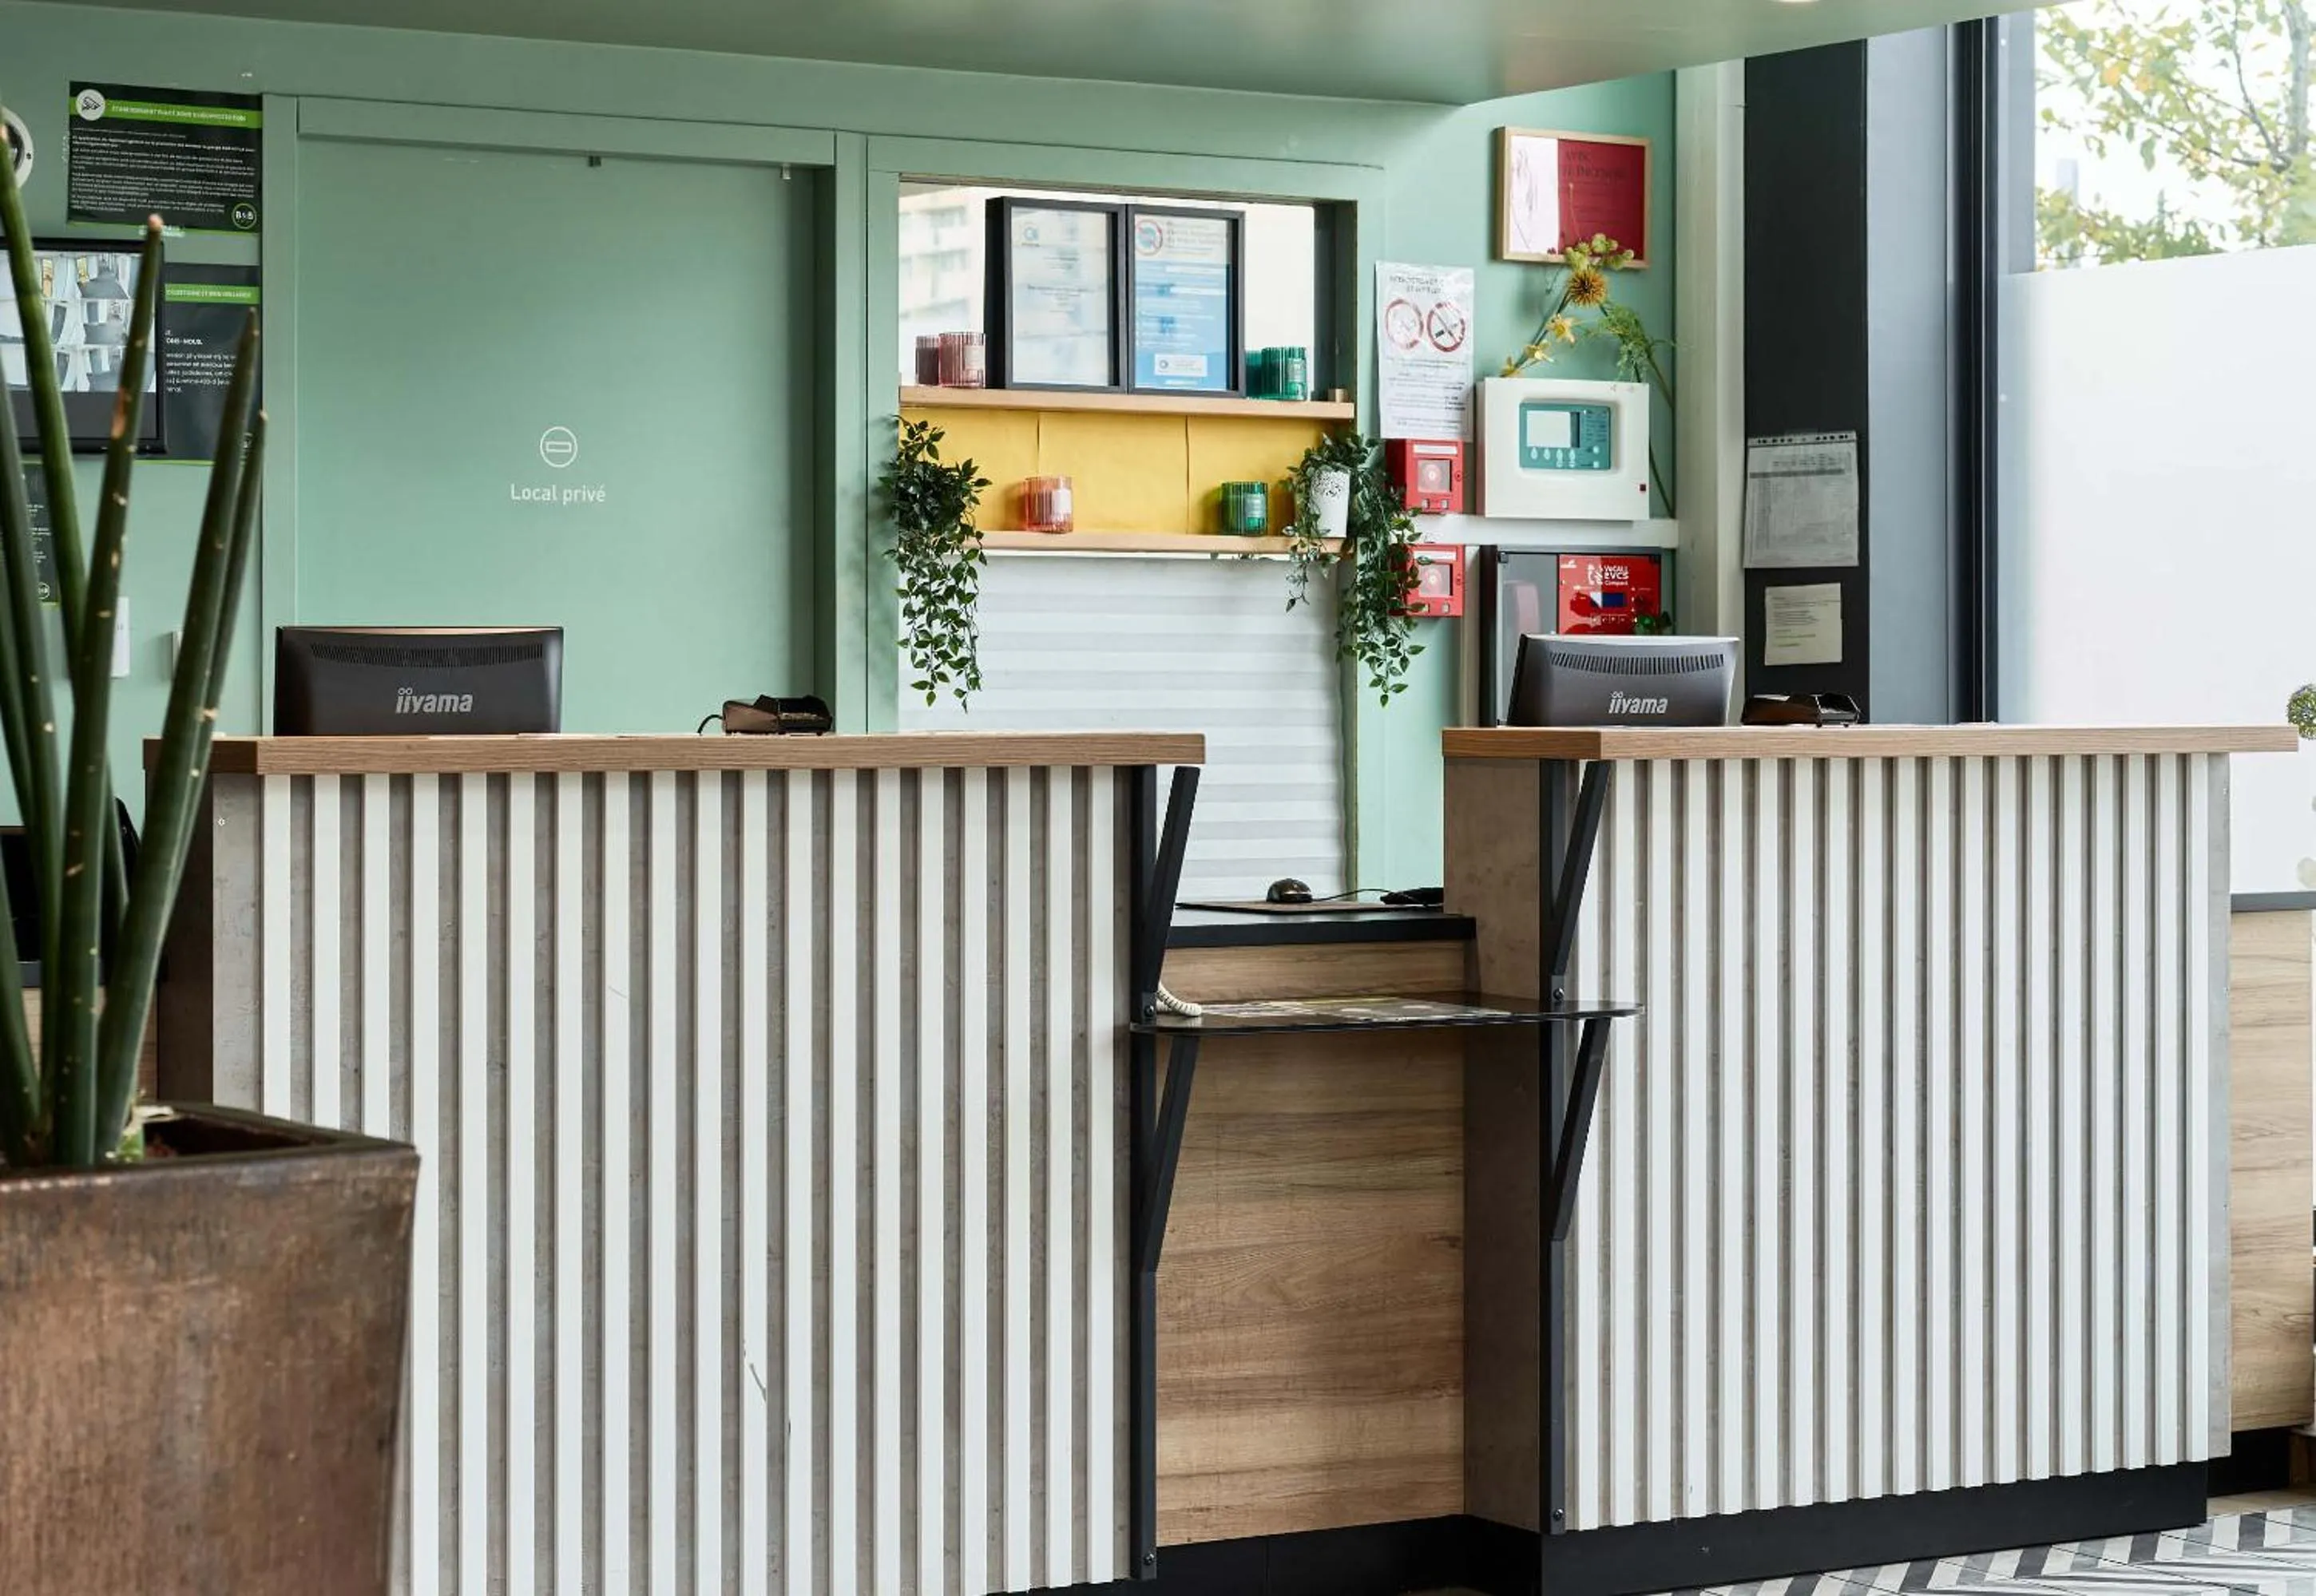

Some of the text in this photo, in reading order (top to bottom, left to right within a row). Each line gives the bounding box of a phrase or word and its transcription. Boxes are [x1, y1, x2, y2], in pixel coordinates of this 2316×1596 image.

[510, 483, 606, 505] Local privé
[395, 687, 473, 714] iiyama
[1608, 691, 1668, 714] iiyama
